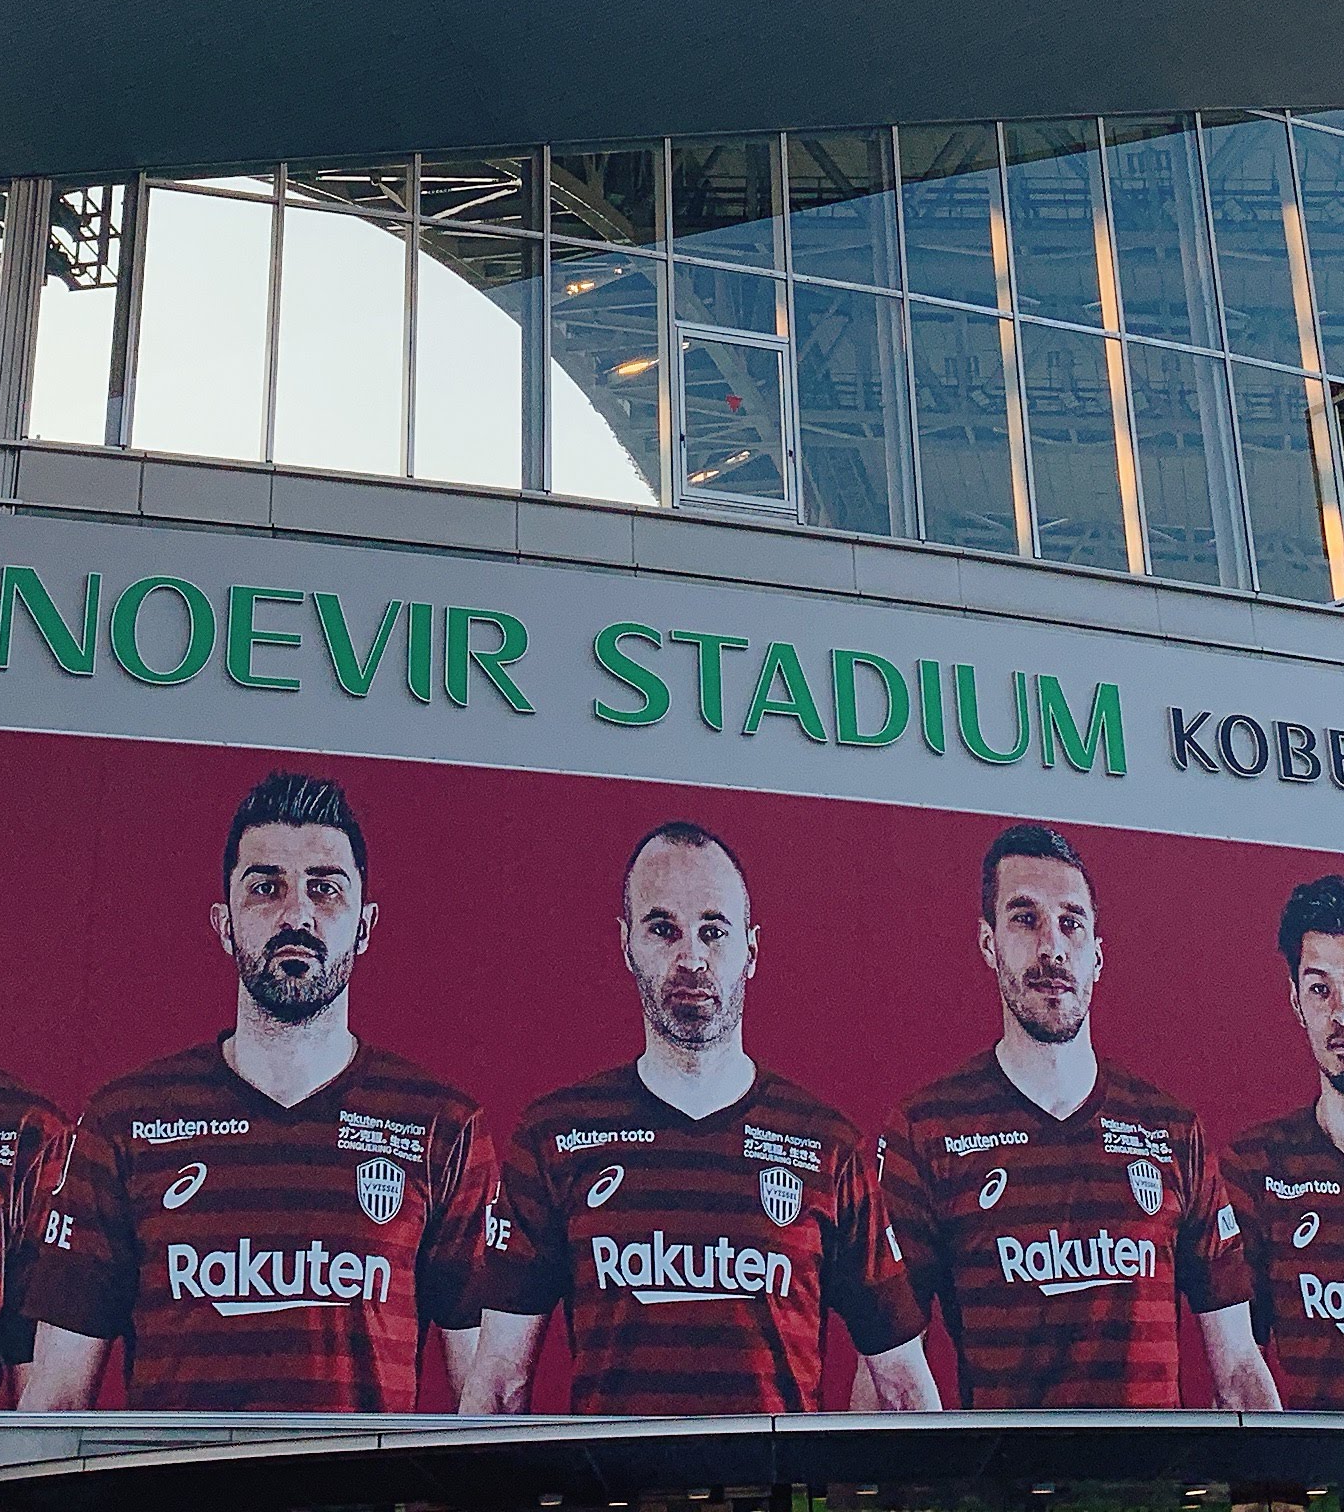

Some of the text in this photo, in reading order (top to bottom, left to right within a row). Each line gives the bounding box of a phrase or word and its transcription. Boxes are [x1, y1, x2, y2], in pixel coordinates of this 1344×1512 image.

[593, 621, 1128, 777] STADIUM
[132, 1118, 250, 1138] Rakuten toto
[339, 1110, 384, 1128] Rakuten
[555, 1128, 655, 1152] Rakuten toto
[944, 1130, 1029, 1153] Rakuten toto
[1264, 1176, 1341, 1196] Rakuten toto
[592, 1230, 792, 1298] Rakuten
[996, 1228, 1156, 1283] Rakuten
[167, 1238, 391, 1303] Rakuten
